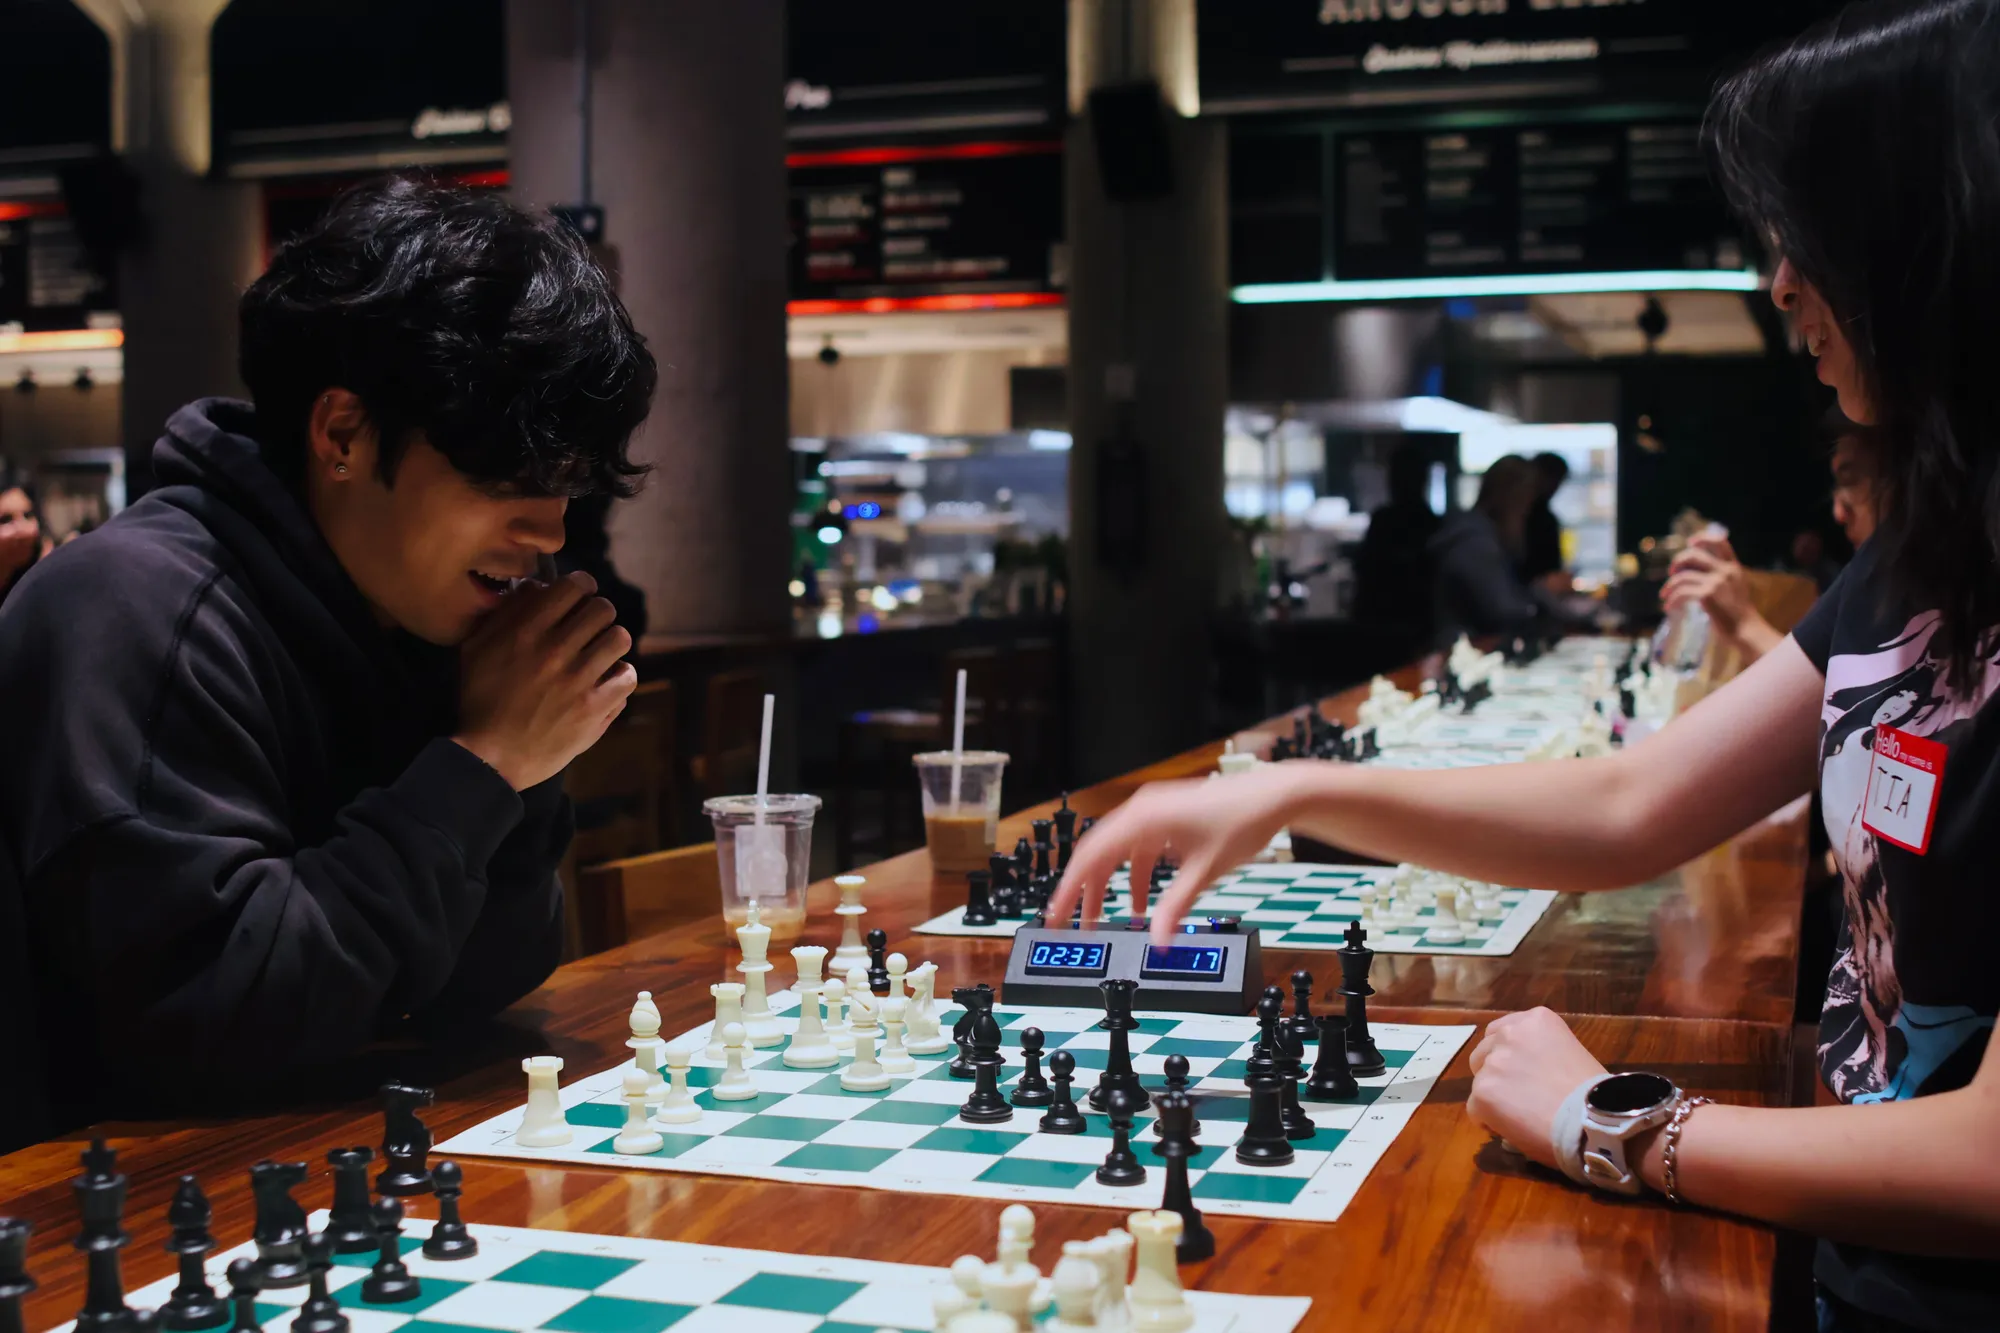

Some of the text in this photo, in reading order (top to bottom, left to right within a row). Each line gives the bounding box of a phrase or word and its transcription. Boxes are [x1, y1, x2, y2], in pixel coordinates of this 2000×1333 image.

[1874, 728, 1901, 758] Hello
[1874, 766, 1912, 819] TIA
[1032, 945, 1102, 967] 02:33
[1192, 951, 1219, 970] 17
